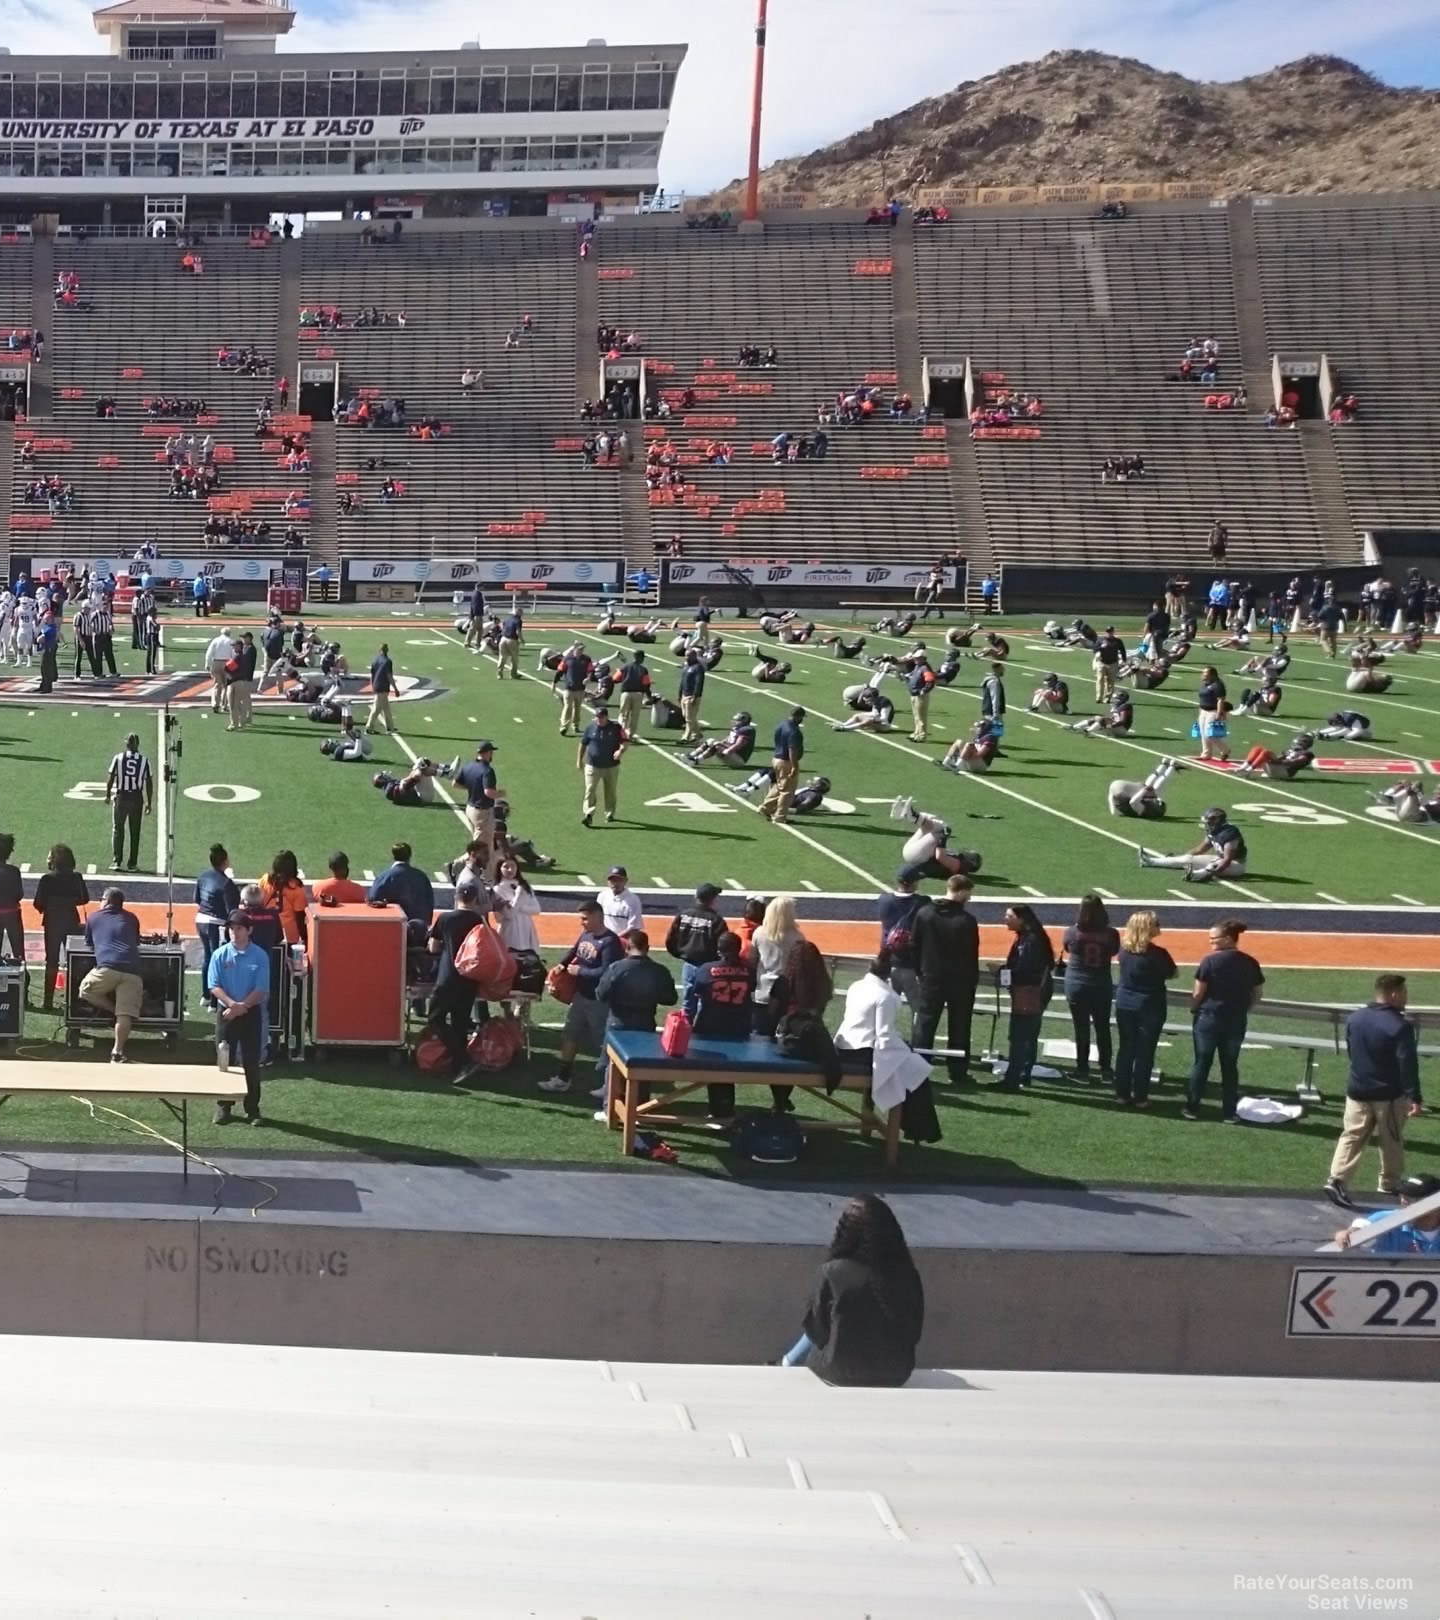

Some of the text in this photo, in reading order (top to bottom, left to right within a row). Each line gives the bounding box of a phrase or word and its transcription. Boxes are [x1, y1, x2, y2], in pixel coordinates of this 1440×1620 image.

[1, 121, 129, 138] UNIVERSITY
[135, 121, 162, 138] OF
[169, 121, 239, 138] TEXAS
[245, 120, 277, 138] AT
[281, 120, 305, 137] EL
[312, 119, 374, 137] PASO
[399, 117, 426, 136] UTEP
[922, 190, 971, 199] SUN BOWL
[1063, 187, 1091, 195] BOWL
[926, 198, 966, 206] STADIUM
[203, 561, 226, 576] UTEP
[372, 563, 554, 580] UTEP UTEP UTEP
[671, 565, 696, 581] UTEP
[767, 566, 793, 582] UTEP
[865, 567, 891, 584] UTEP
[126, 759, 138, 776] S
[145, 1246, 349, 1277] NO SMOKING
[1362, 1279, 1439, 1327] 22
